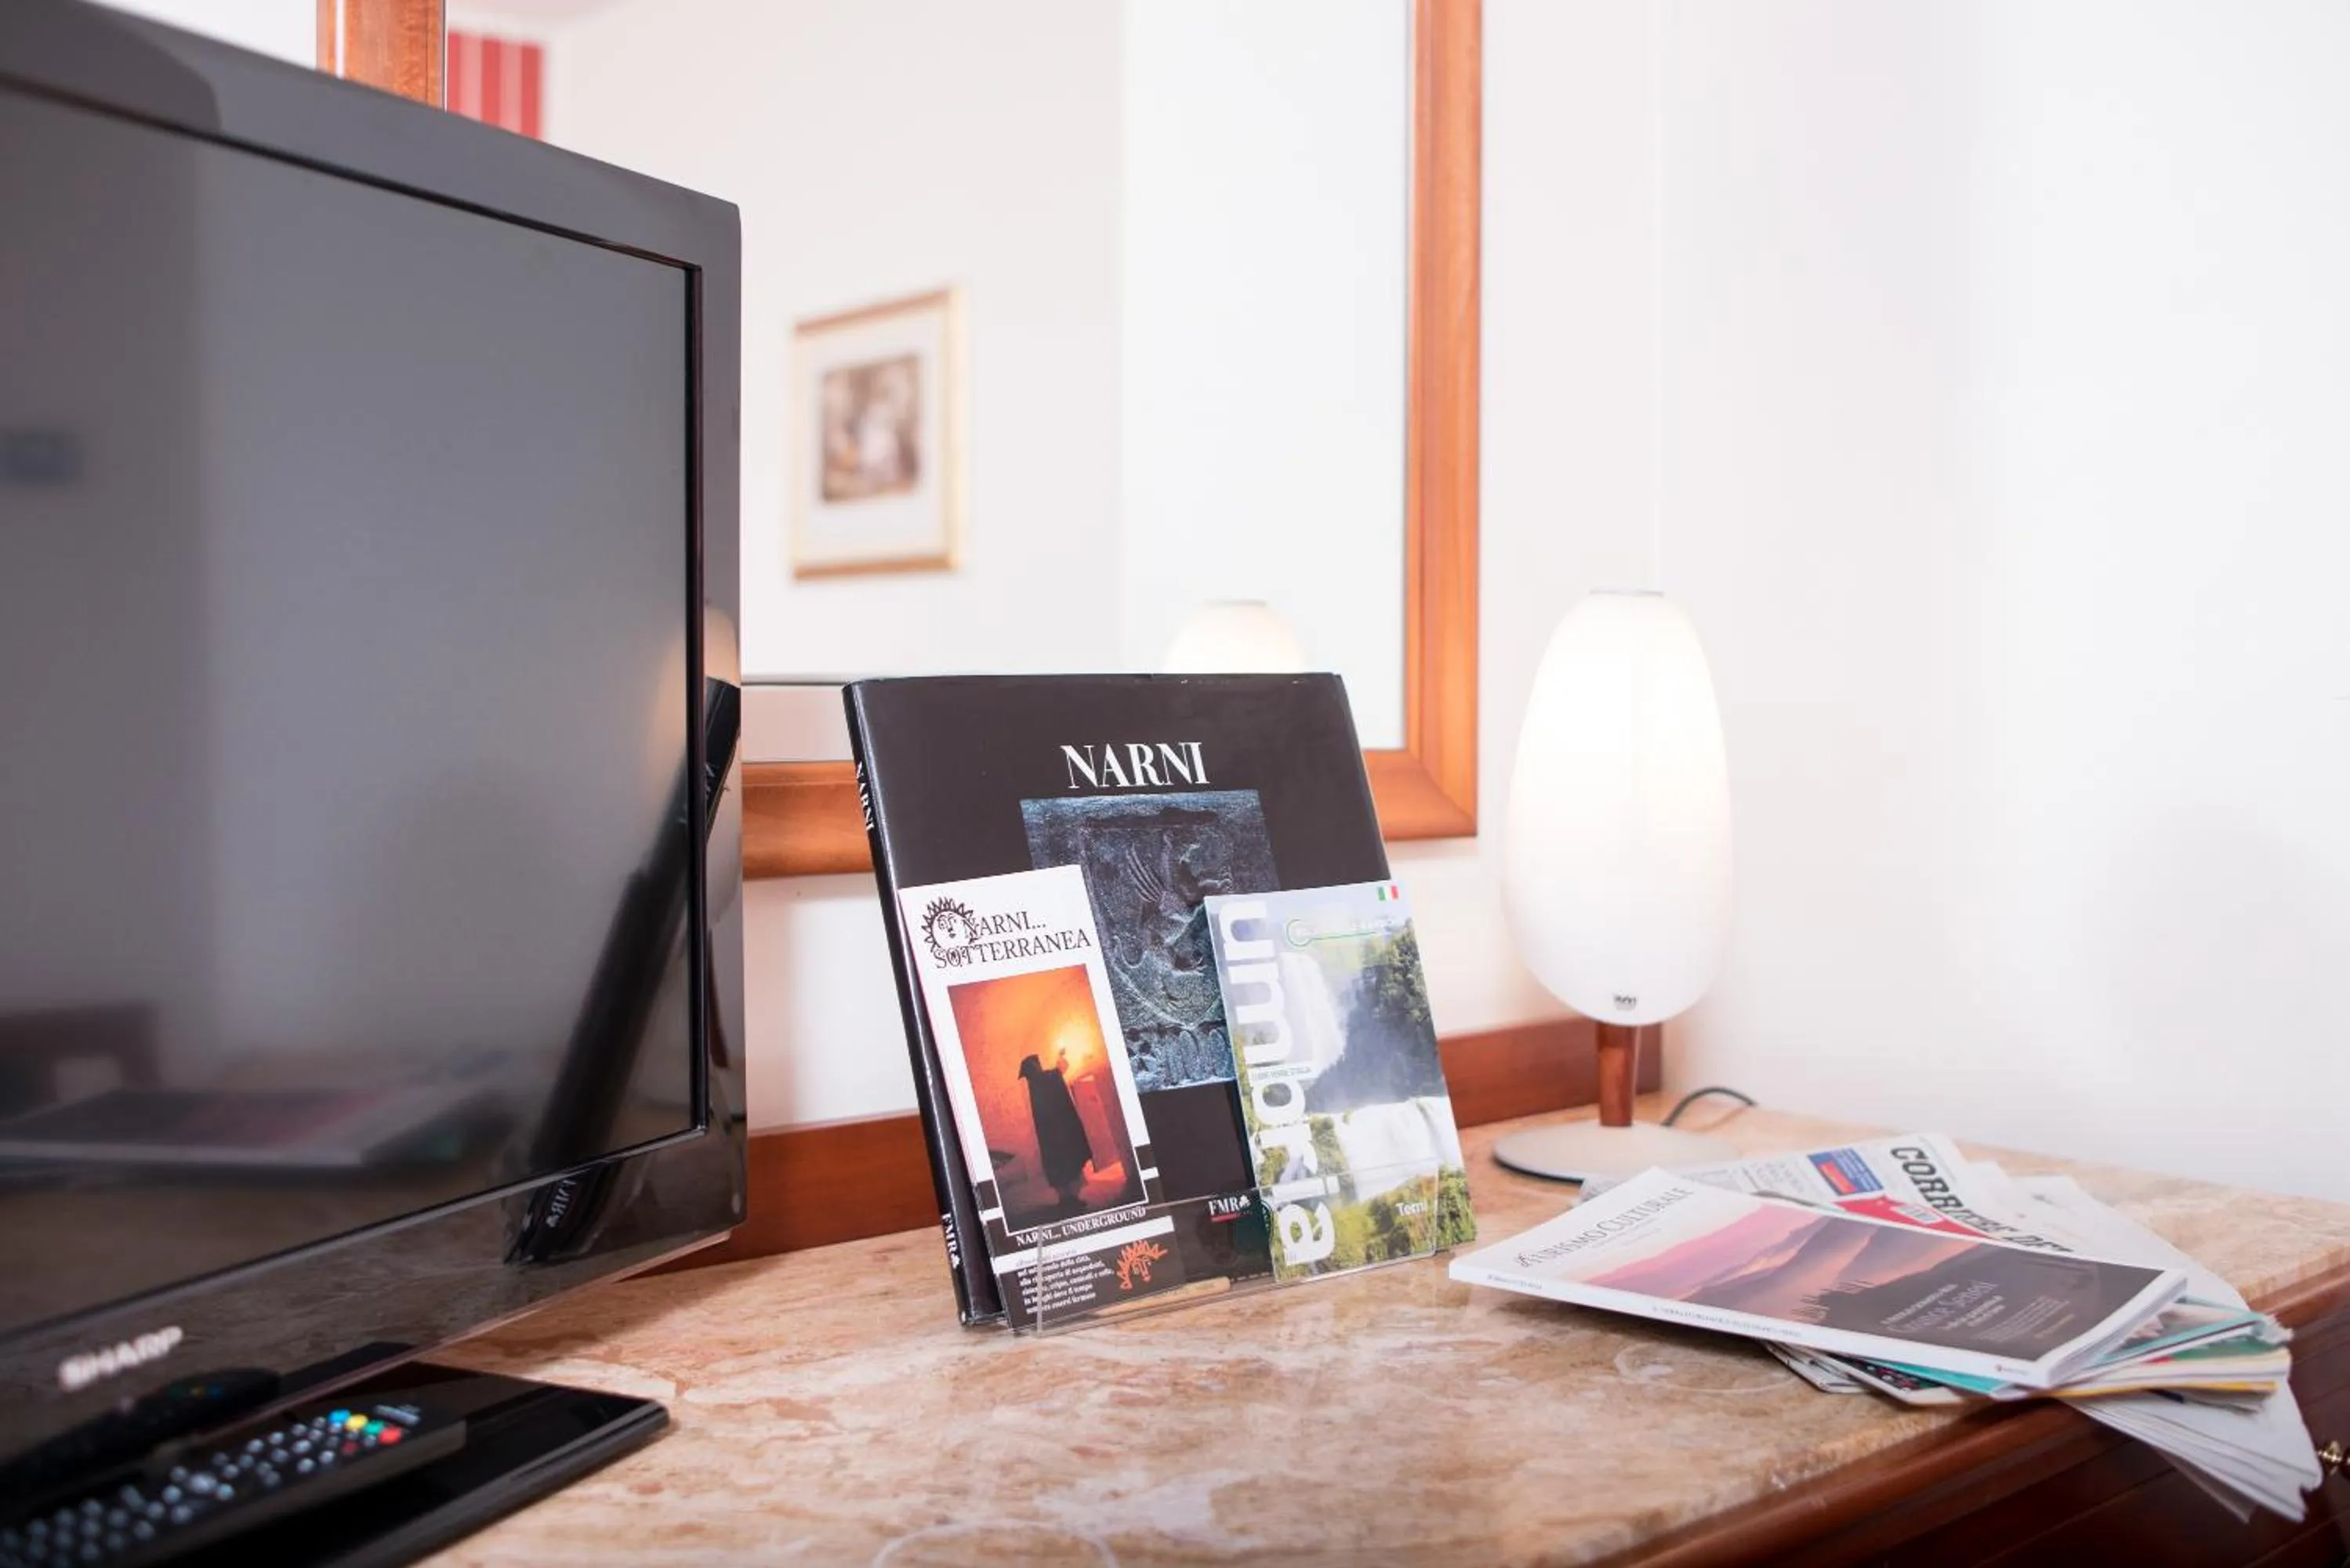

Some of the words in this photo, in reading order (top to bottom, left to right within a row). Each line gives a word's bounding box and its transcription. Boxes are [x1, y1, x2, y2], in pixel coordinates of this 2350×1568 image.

[1060, 742, 1210, 789] NARNI
[934, 929, 1091, 969] SOTTERRANEA
[1220, 901, 1340, 1267] umbria
[1062, 1207, 1146, 1236] UNDERGROUND
[1208, 1197, 1239, 1215] FMR
[59, 1326, 183, 1392] SHARP
